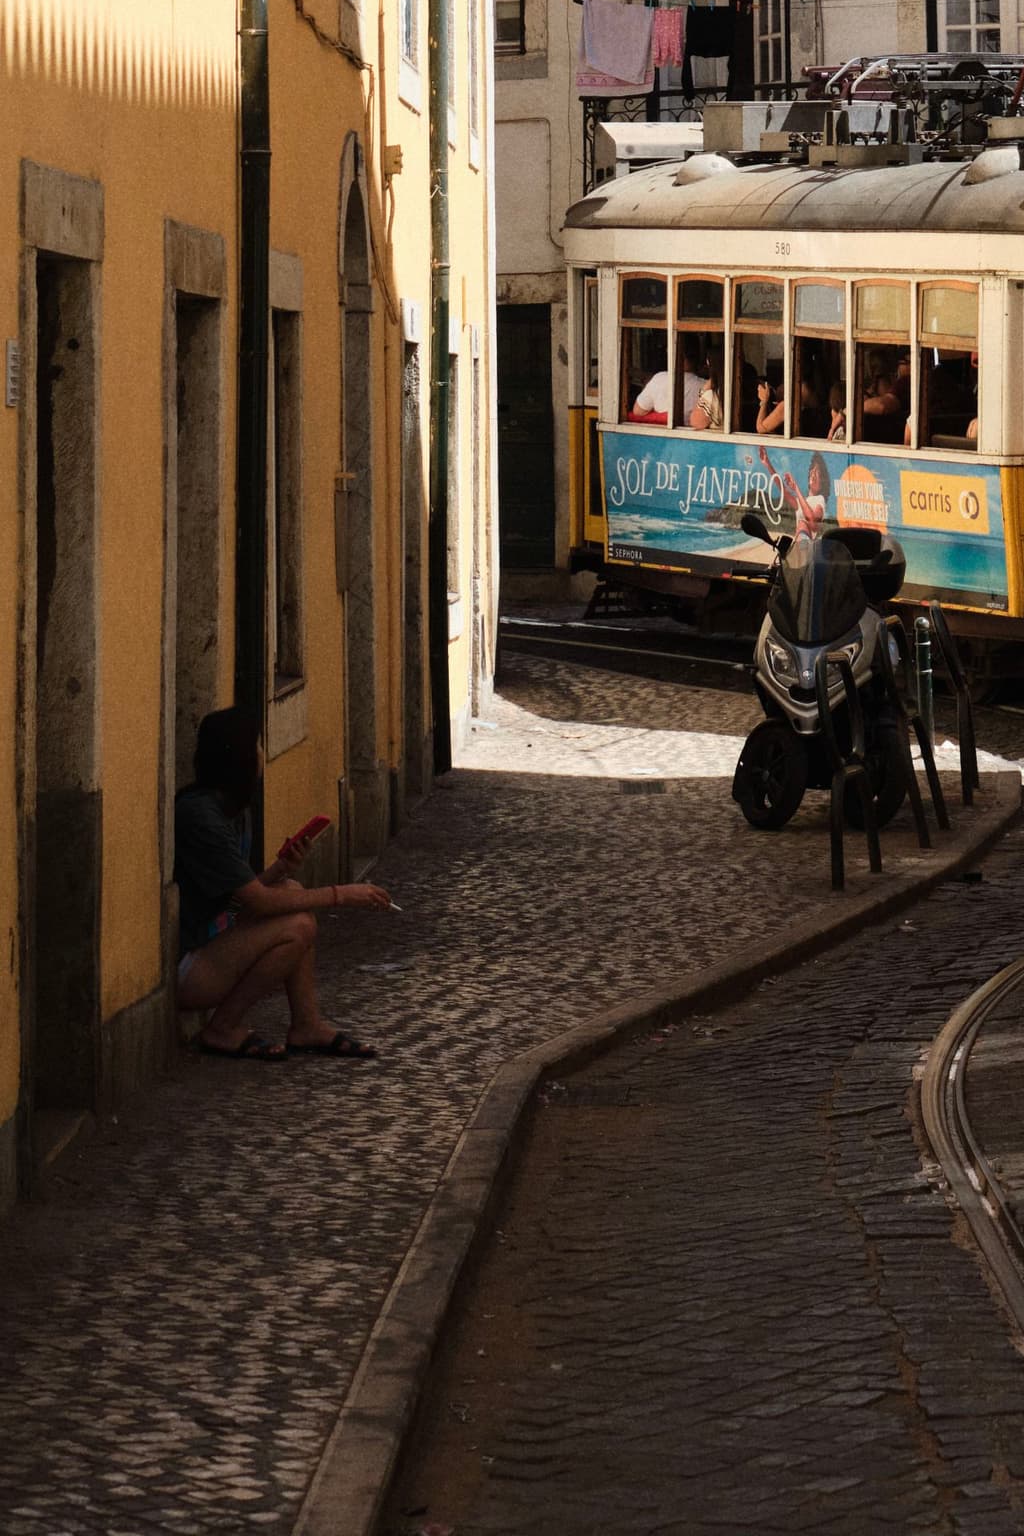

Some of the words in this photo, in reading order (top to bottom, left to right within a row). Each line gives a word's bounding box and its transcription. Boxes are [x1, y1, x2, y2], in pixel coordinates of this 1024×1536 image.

[775, 241, 791, 256] 580
[610, 457, 653, 506] SOL
[656, 461, 680, 491] DE
[679, 462, 785, 525] JANEIRO
[909, 485, 952, 513] carris
[615, 548, 643, 561] SEPHORA
